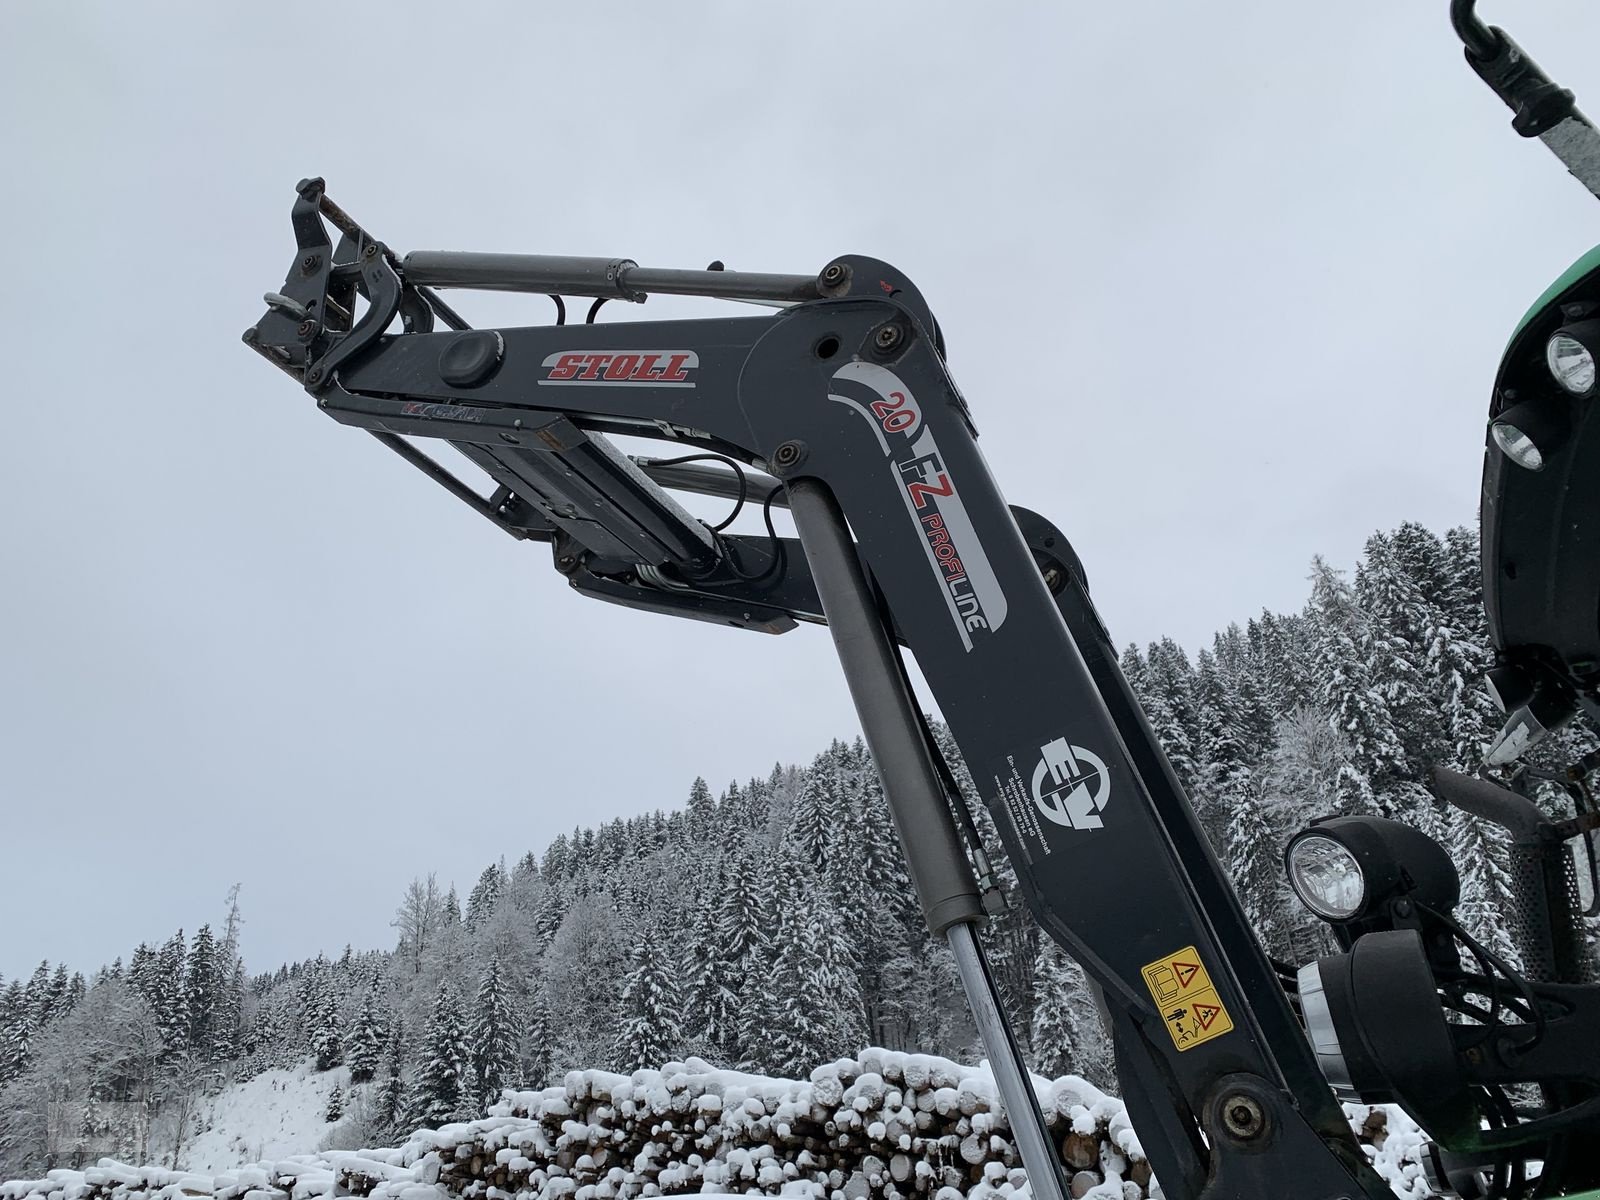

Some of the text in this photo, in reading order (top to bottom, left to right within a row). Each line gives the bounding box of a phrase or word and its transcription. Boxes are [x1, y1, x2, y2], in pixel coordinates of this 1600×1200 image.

[547, 354, 690, 381] STOLL
[869, 391, 988, 633] 20 FZ PROFILINE
[1006, 755, 1015, 768] Ein-
[1011, 767, 1020, 780] und
[1008, 777, 1036, 837] Schrobenhausen eG
